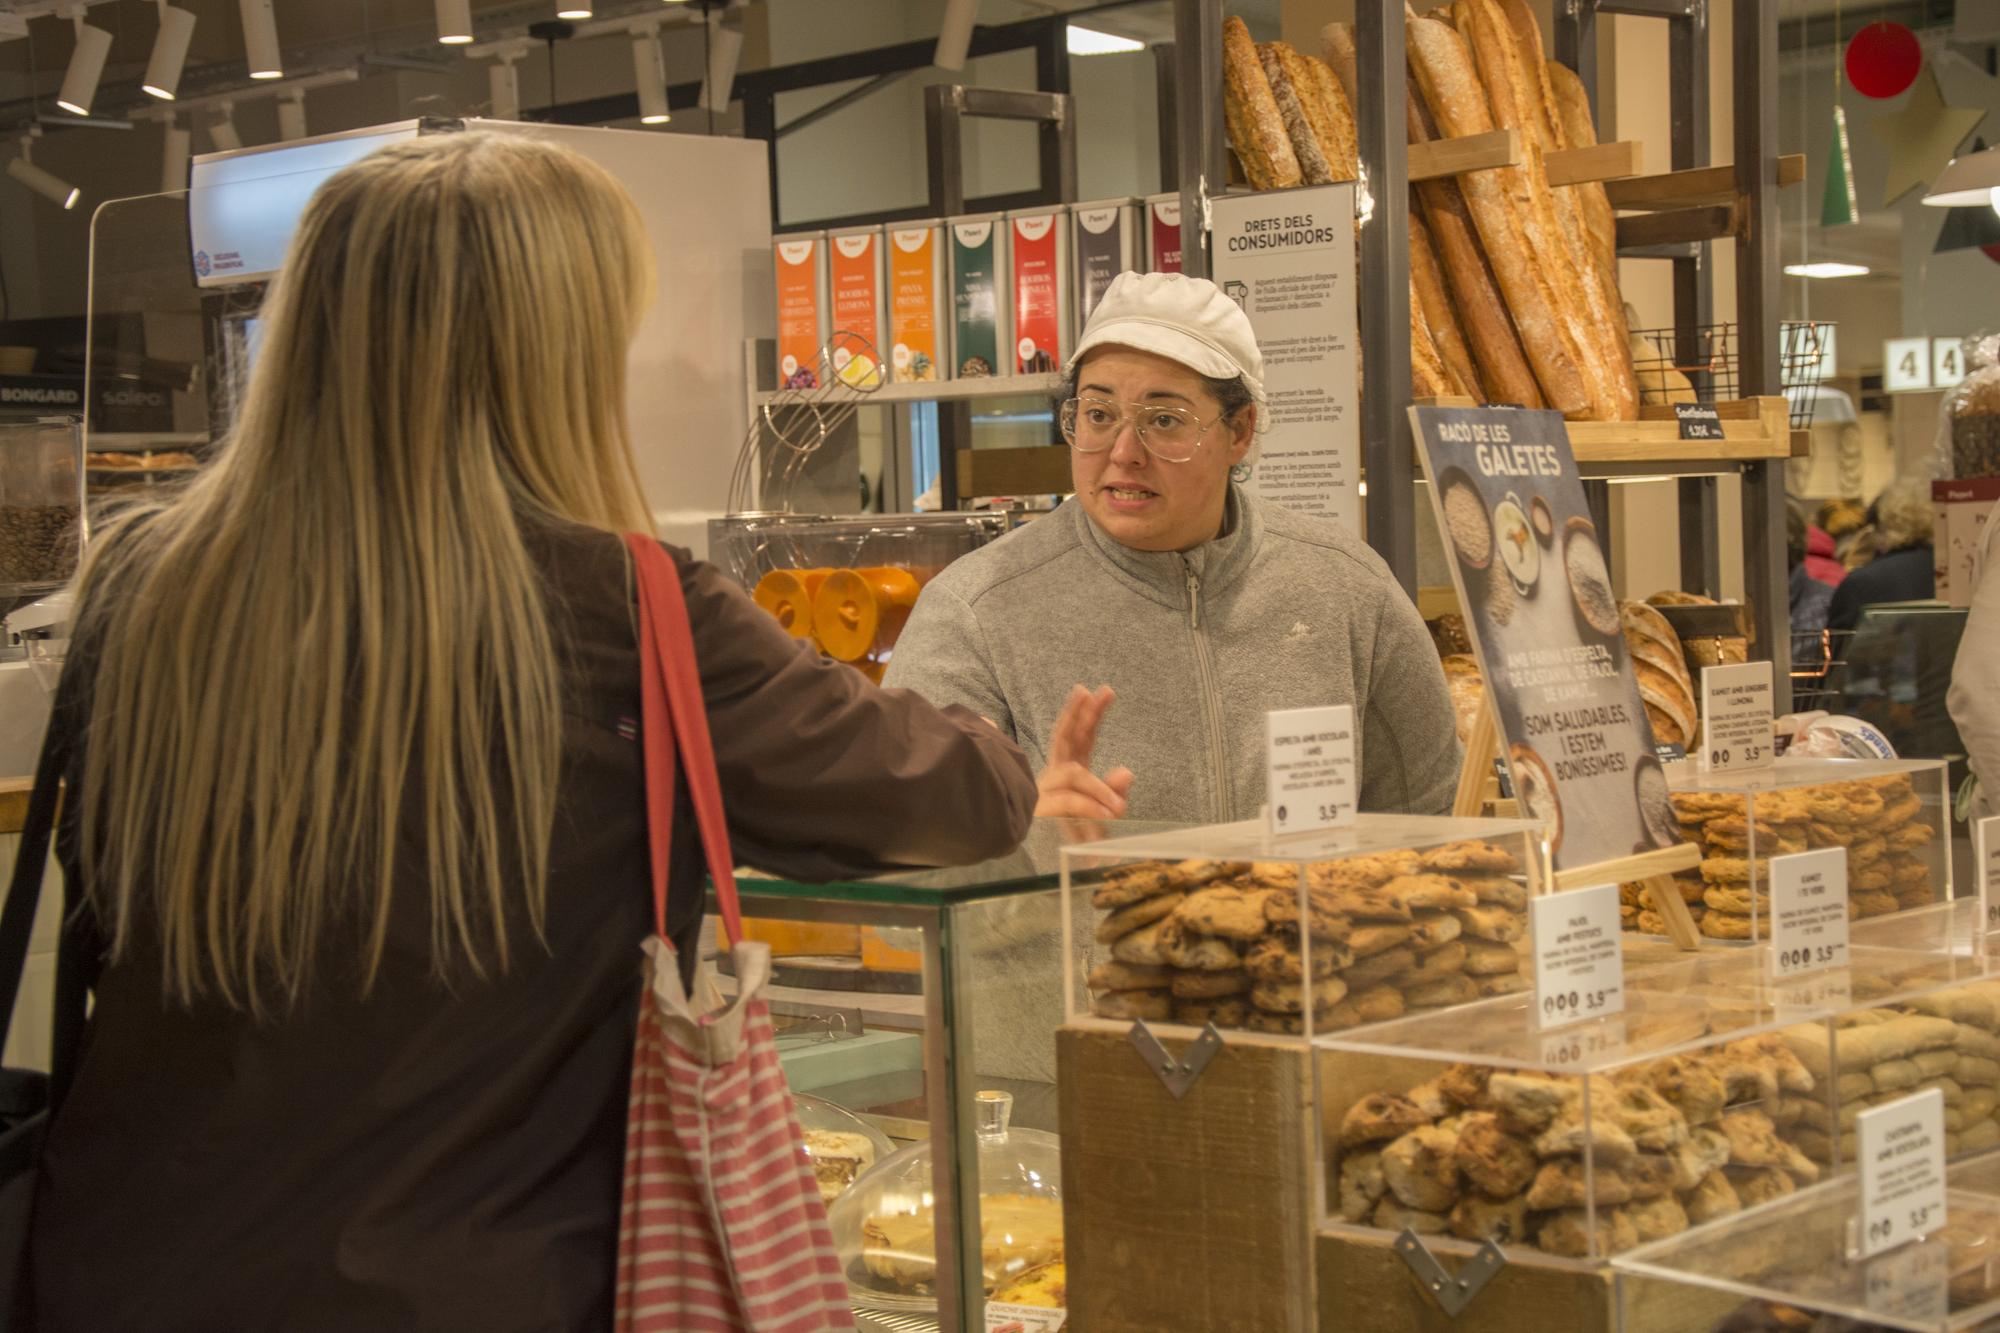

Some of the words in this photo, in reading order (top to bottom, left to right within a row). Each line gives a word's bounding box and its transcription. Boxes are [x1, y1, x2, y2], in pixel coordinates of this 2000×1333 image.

[1245, 217, 1281, 232] DRETS
[1284, 214, 1313, 228] DELS
[1228, 227, 1333, 251] CONSUMIDORS
[1899, 351, 1917, 377] 4
[1942, 349, 1956, 375] 4
[1, 388, 79, 403] BONGARD
[1471, 424, 1490, 442] DE
[1488, 424, 1511, 443] LES
[1476, 444, 1561, 476] GALETES
[1526, 713, 1553, 735] SOM
[1554, 704, 1631, 732] SALUDABLES,
[1560, 737, 1567, 755] I
[1567, 732, 1606, 754] ESTEM
[1319, 804, 1337, 821] 3,9
[1586, 990, 1605, 1010] 3,9
